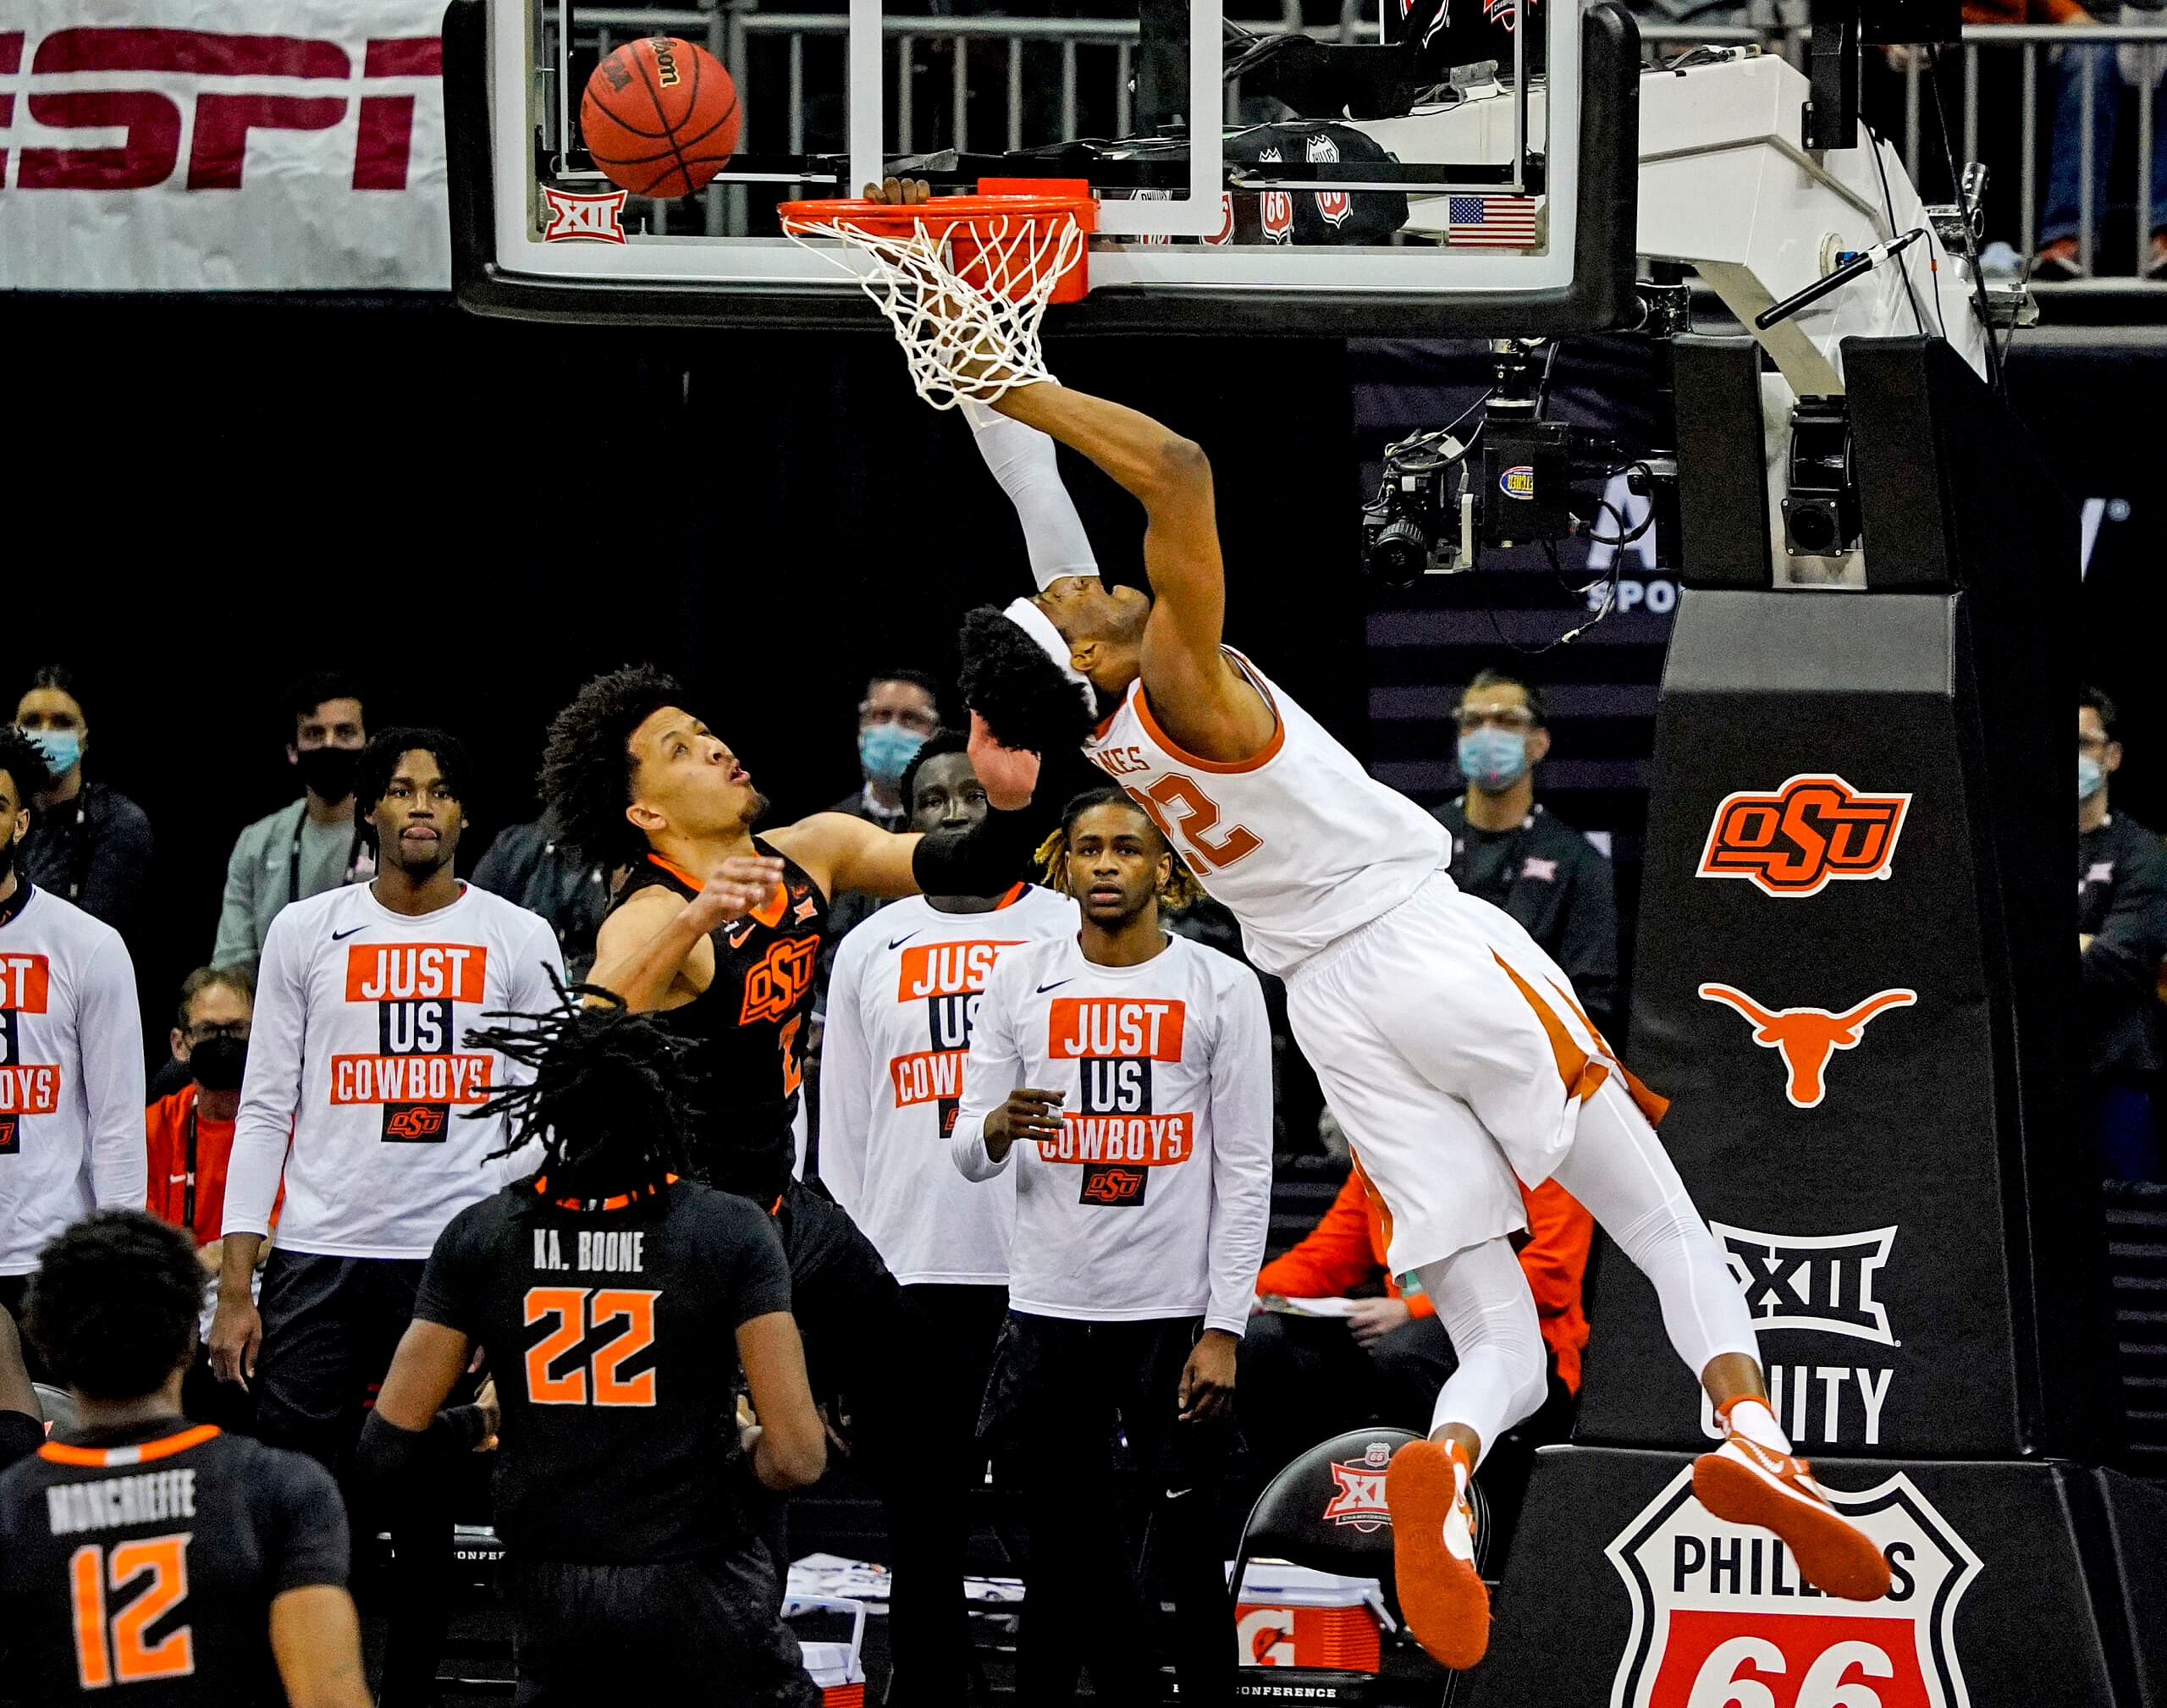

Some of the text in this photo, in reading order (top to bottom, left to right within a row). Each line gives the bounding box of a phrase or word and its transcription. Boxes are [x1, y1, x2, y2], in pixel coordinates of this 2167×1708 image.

[1586, 579, 1677, 614] SPO
[1703, 780, 1905, 890] OSU
[361, 948, 471, 999] JUST
[740, 934, 820, 1024] OSU
[389, 1002, 443, 1053] US
[1064, 1004, 1169, 1056] JUST
[338, 1058, 484, 1100] COWBOYS
[1090, 1060, 1142, 1112] US
[388, 1107, 444, 1138] OSU
[1085, 1169, 1143, 1202] OSU
[533, 1228, 644, 1272] KA. BOONE
[523, 1287, 664, 1407] 22
[1673, 1534, 1916, 1602] PHILS
[69, 1531, 196, 1690] 12
[1236, 1685, 1337, 1698] ONFERENCE
